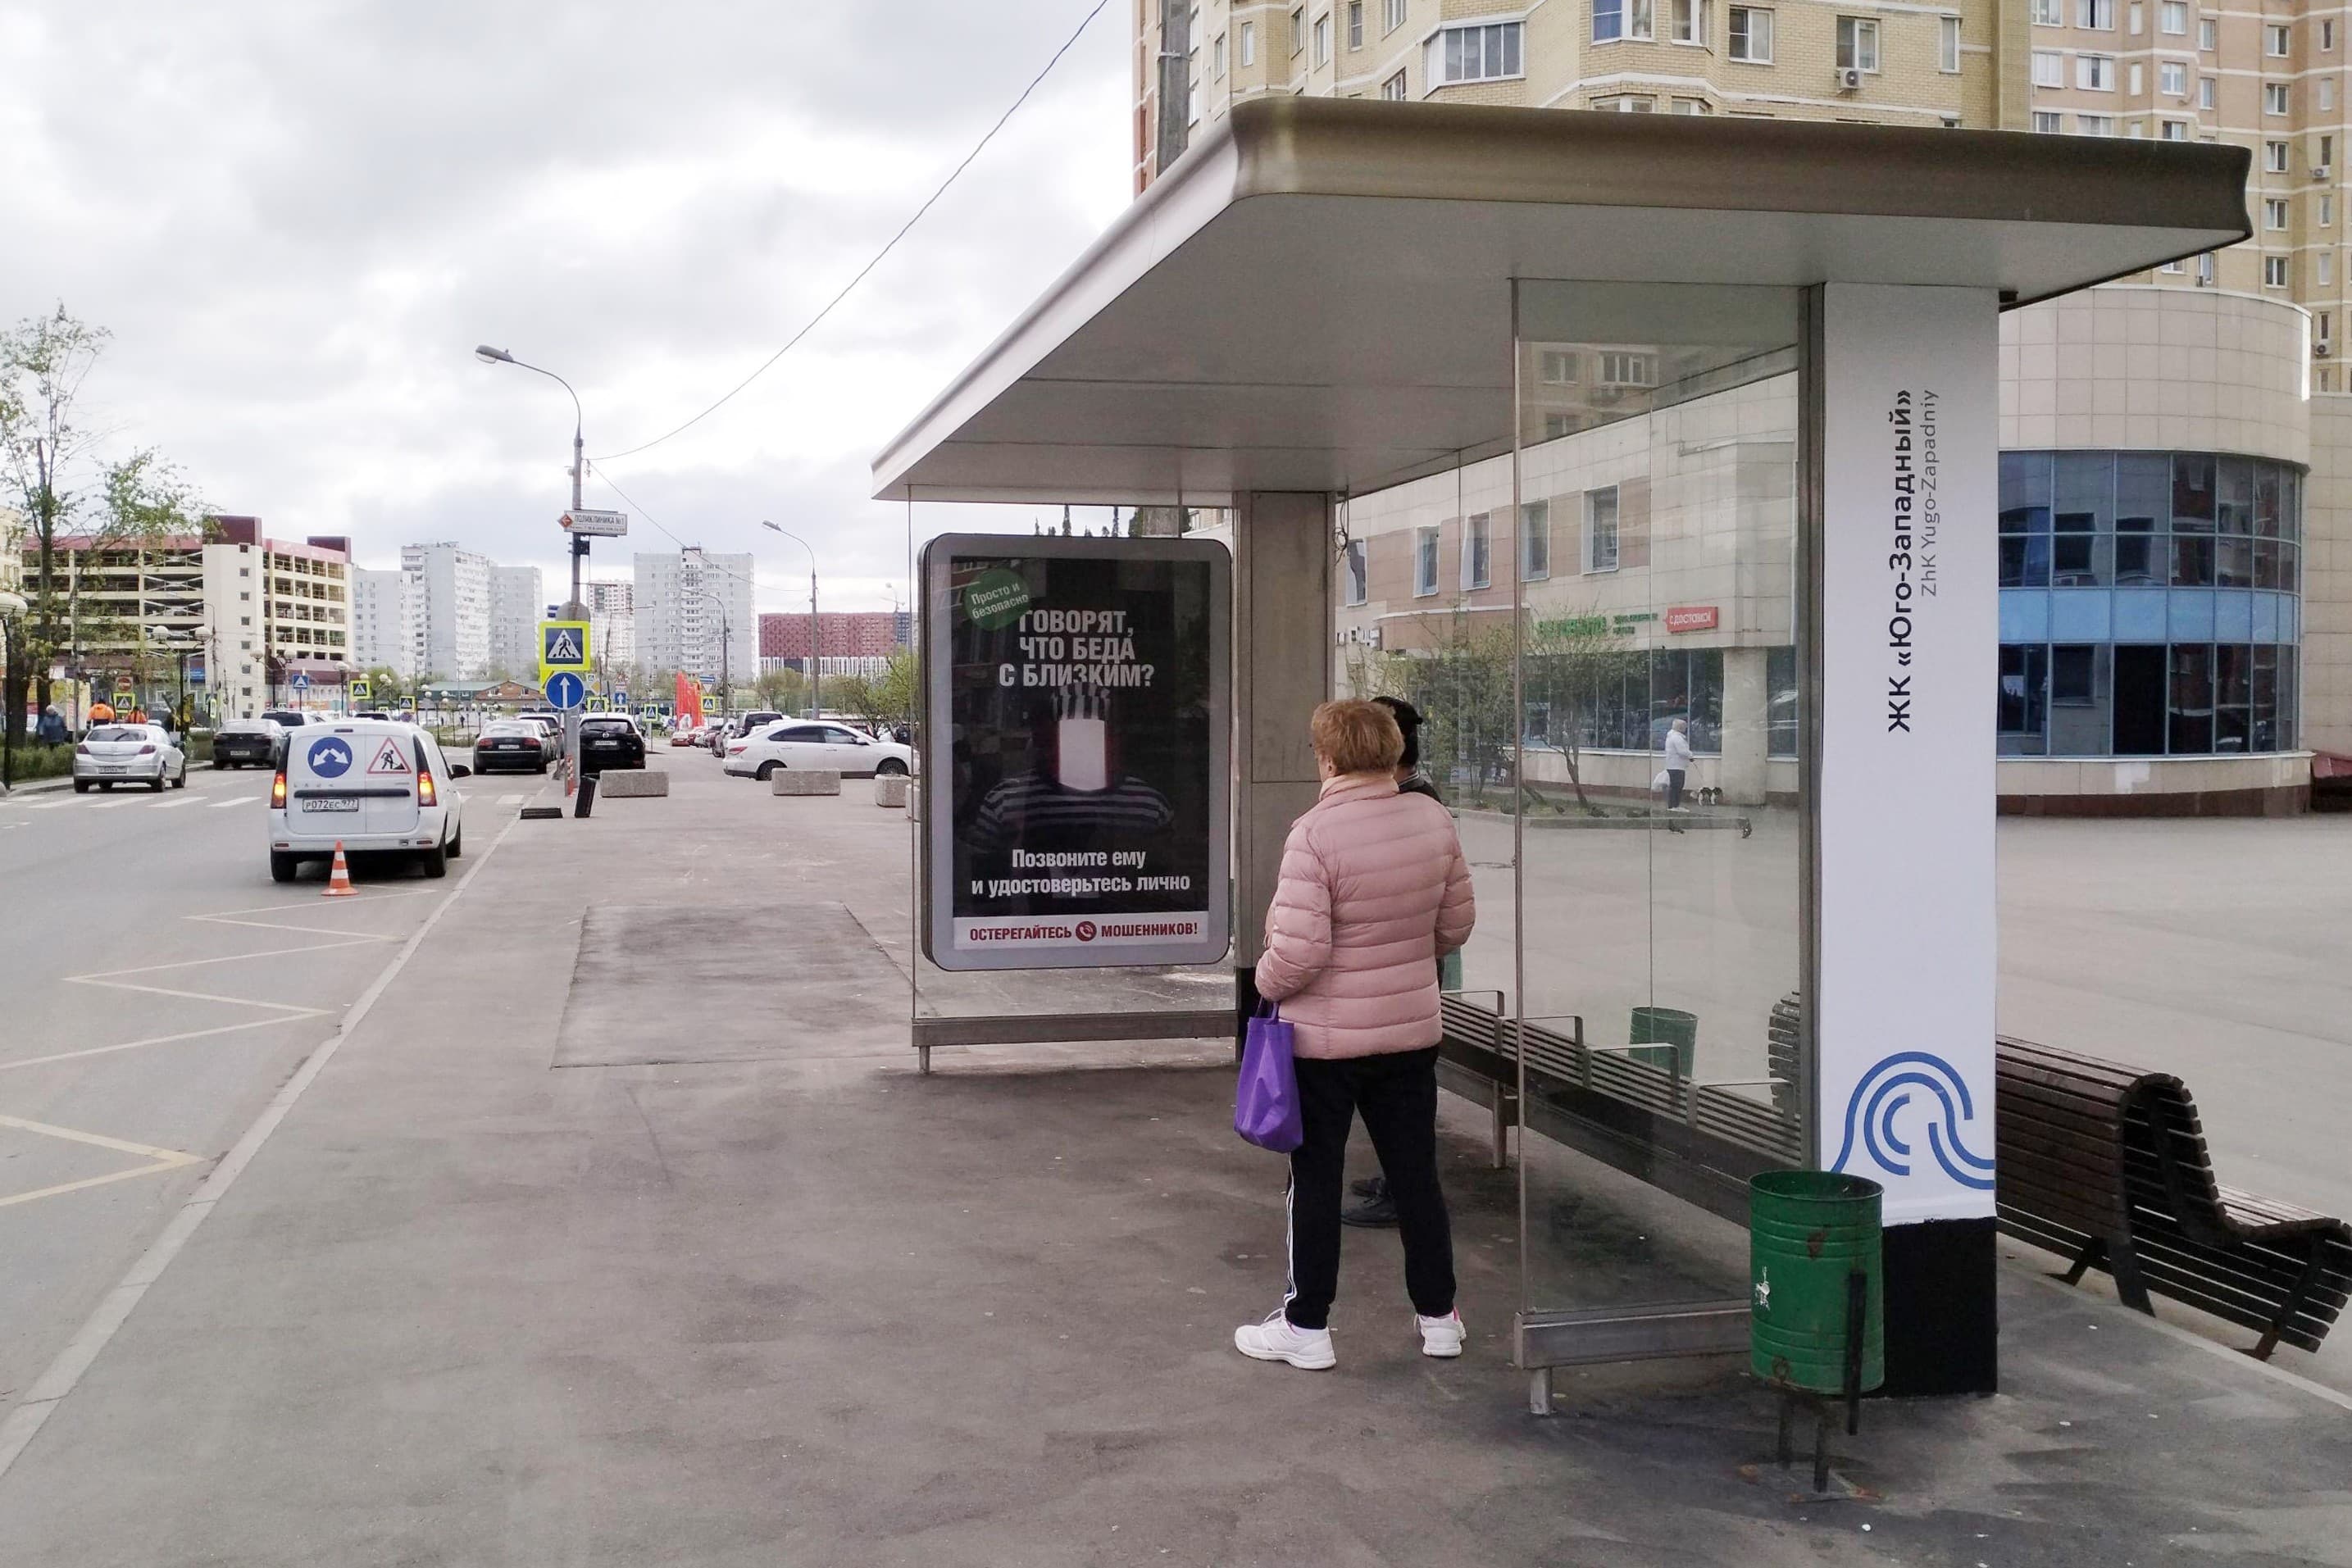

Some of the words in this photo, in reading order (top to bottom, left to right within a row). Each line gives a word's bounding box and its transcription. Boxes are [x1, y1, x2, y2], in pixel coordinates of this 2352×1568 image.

[1921, 389, 1940, 548] Yugo-Zapadniy
[1889, 389, 1915, 667] «Юго-Западный»
[1922, 554, 1936, 597] ZhK
[971, 585, 1010, 605] Просто
[971, 594, 1029, 619] безопасно
[1020, 610, 1133, 636] ГОВОРЯТ,
[1020, 638, 1065, 660] ЧТО
[1072, 637, 1135, 664] БЕДА
[999, 664, 1015, 687] С
[1023, 664, 1154, 687] БЛИЗКИМ?
[1888, 675, 1911, 733] ЖК
[1012, 848, 1108, 868] Позвоните
[1112, 850, 1147, 869] ему
[971, 882, 983, 895] и
[989, 876, 1132, 898] удостоверьтесь
[1136, 875, 1190, 891] лично
[970, 925, 1072, 941] ОСТЕРЕГАЙТЕСЬ
[1101, 922, 1198, 938] МОШЕННИКОВ!
